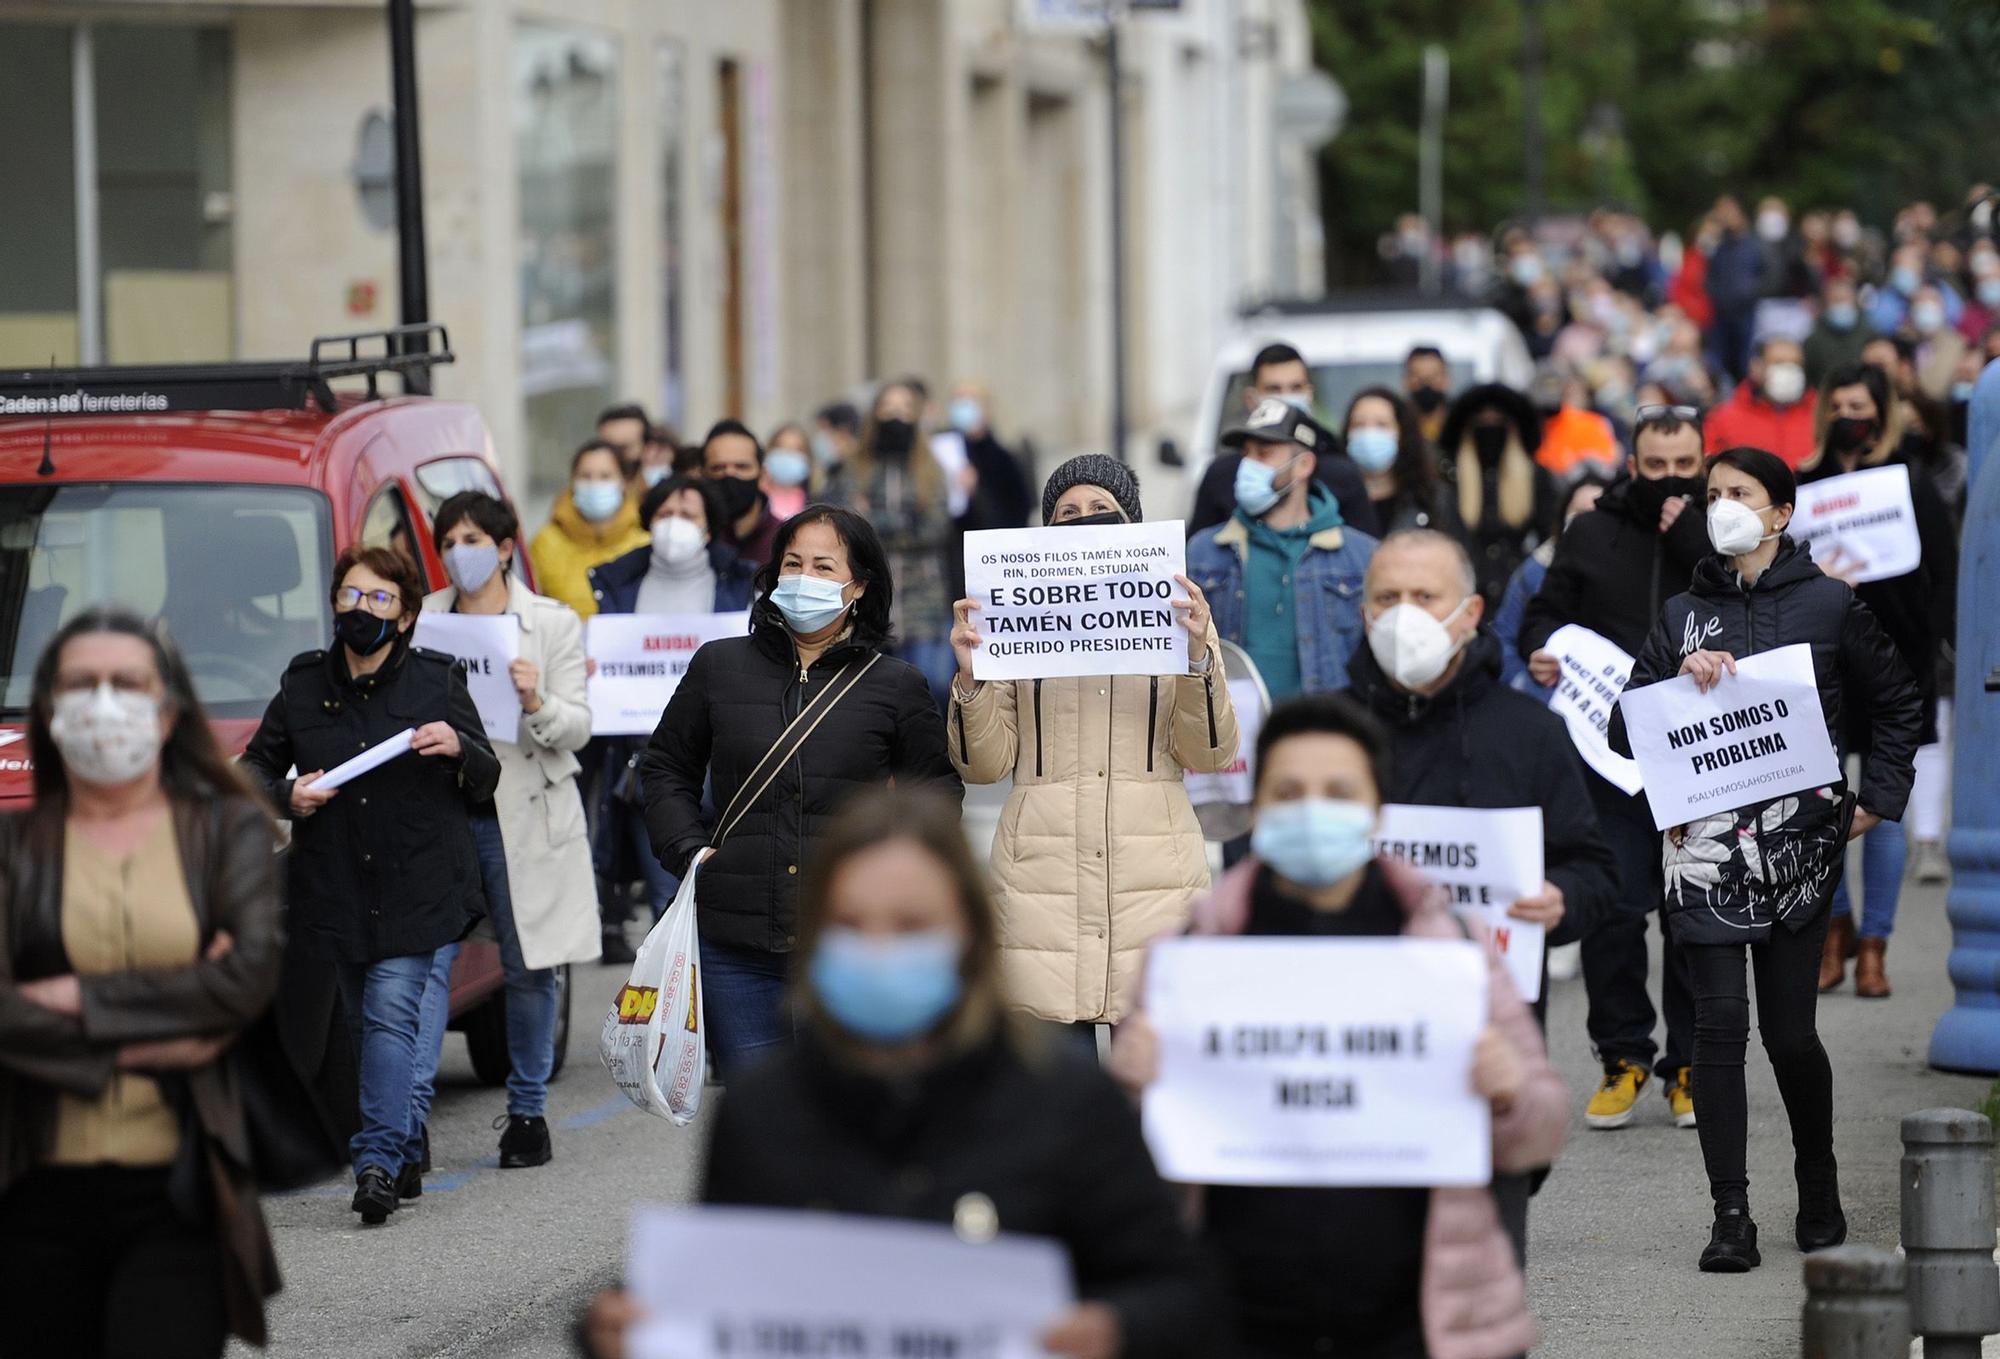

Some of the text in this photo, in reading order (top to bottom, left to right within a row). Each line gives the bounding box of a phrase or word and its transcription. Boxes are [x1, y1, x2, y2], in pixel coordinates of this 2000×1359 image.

[82, 391, 169, 412] ferreterías
[981, 546, 1170, 565] OS NOSOS FILOS TAMÉN XOGAN,
[1003, 562, 1149, 580] RIN, DORMEN, ESTUDIAN
[989, 580, 1172, 607] E SOBRE TODO
[984, 610, 1172, 633] TAMÉN COMEN
[989, 637, 1173, 658] QUERIDO PRESIDENTE
[1667, 699, 1789, 750] NON SOMOS O
[1691, 731, 1788, 775] PROBLEMA
[1687, 764, 1806, 805] #SALVEMOSLAHOSTELERIA
